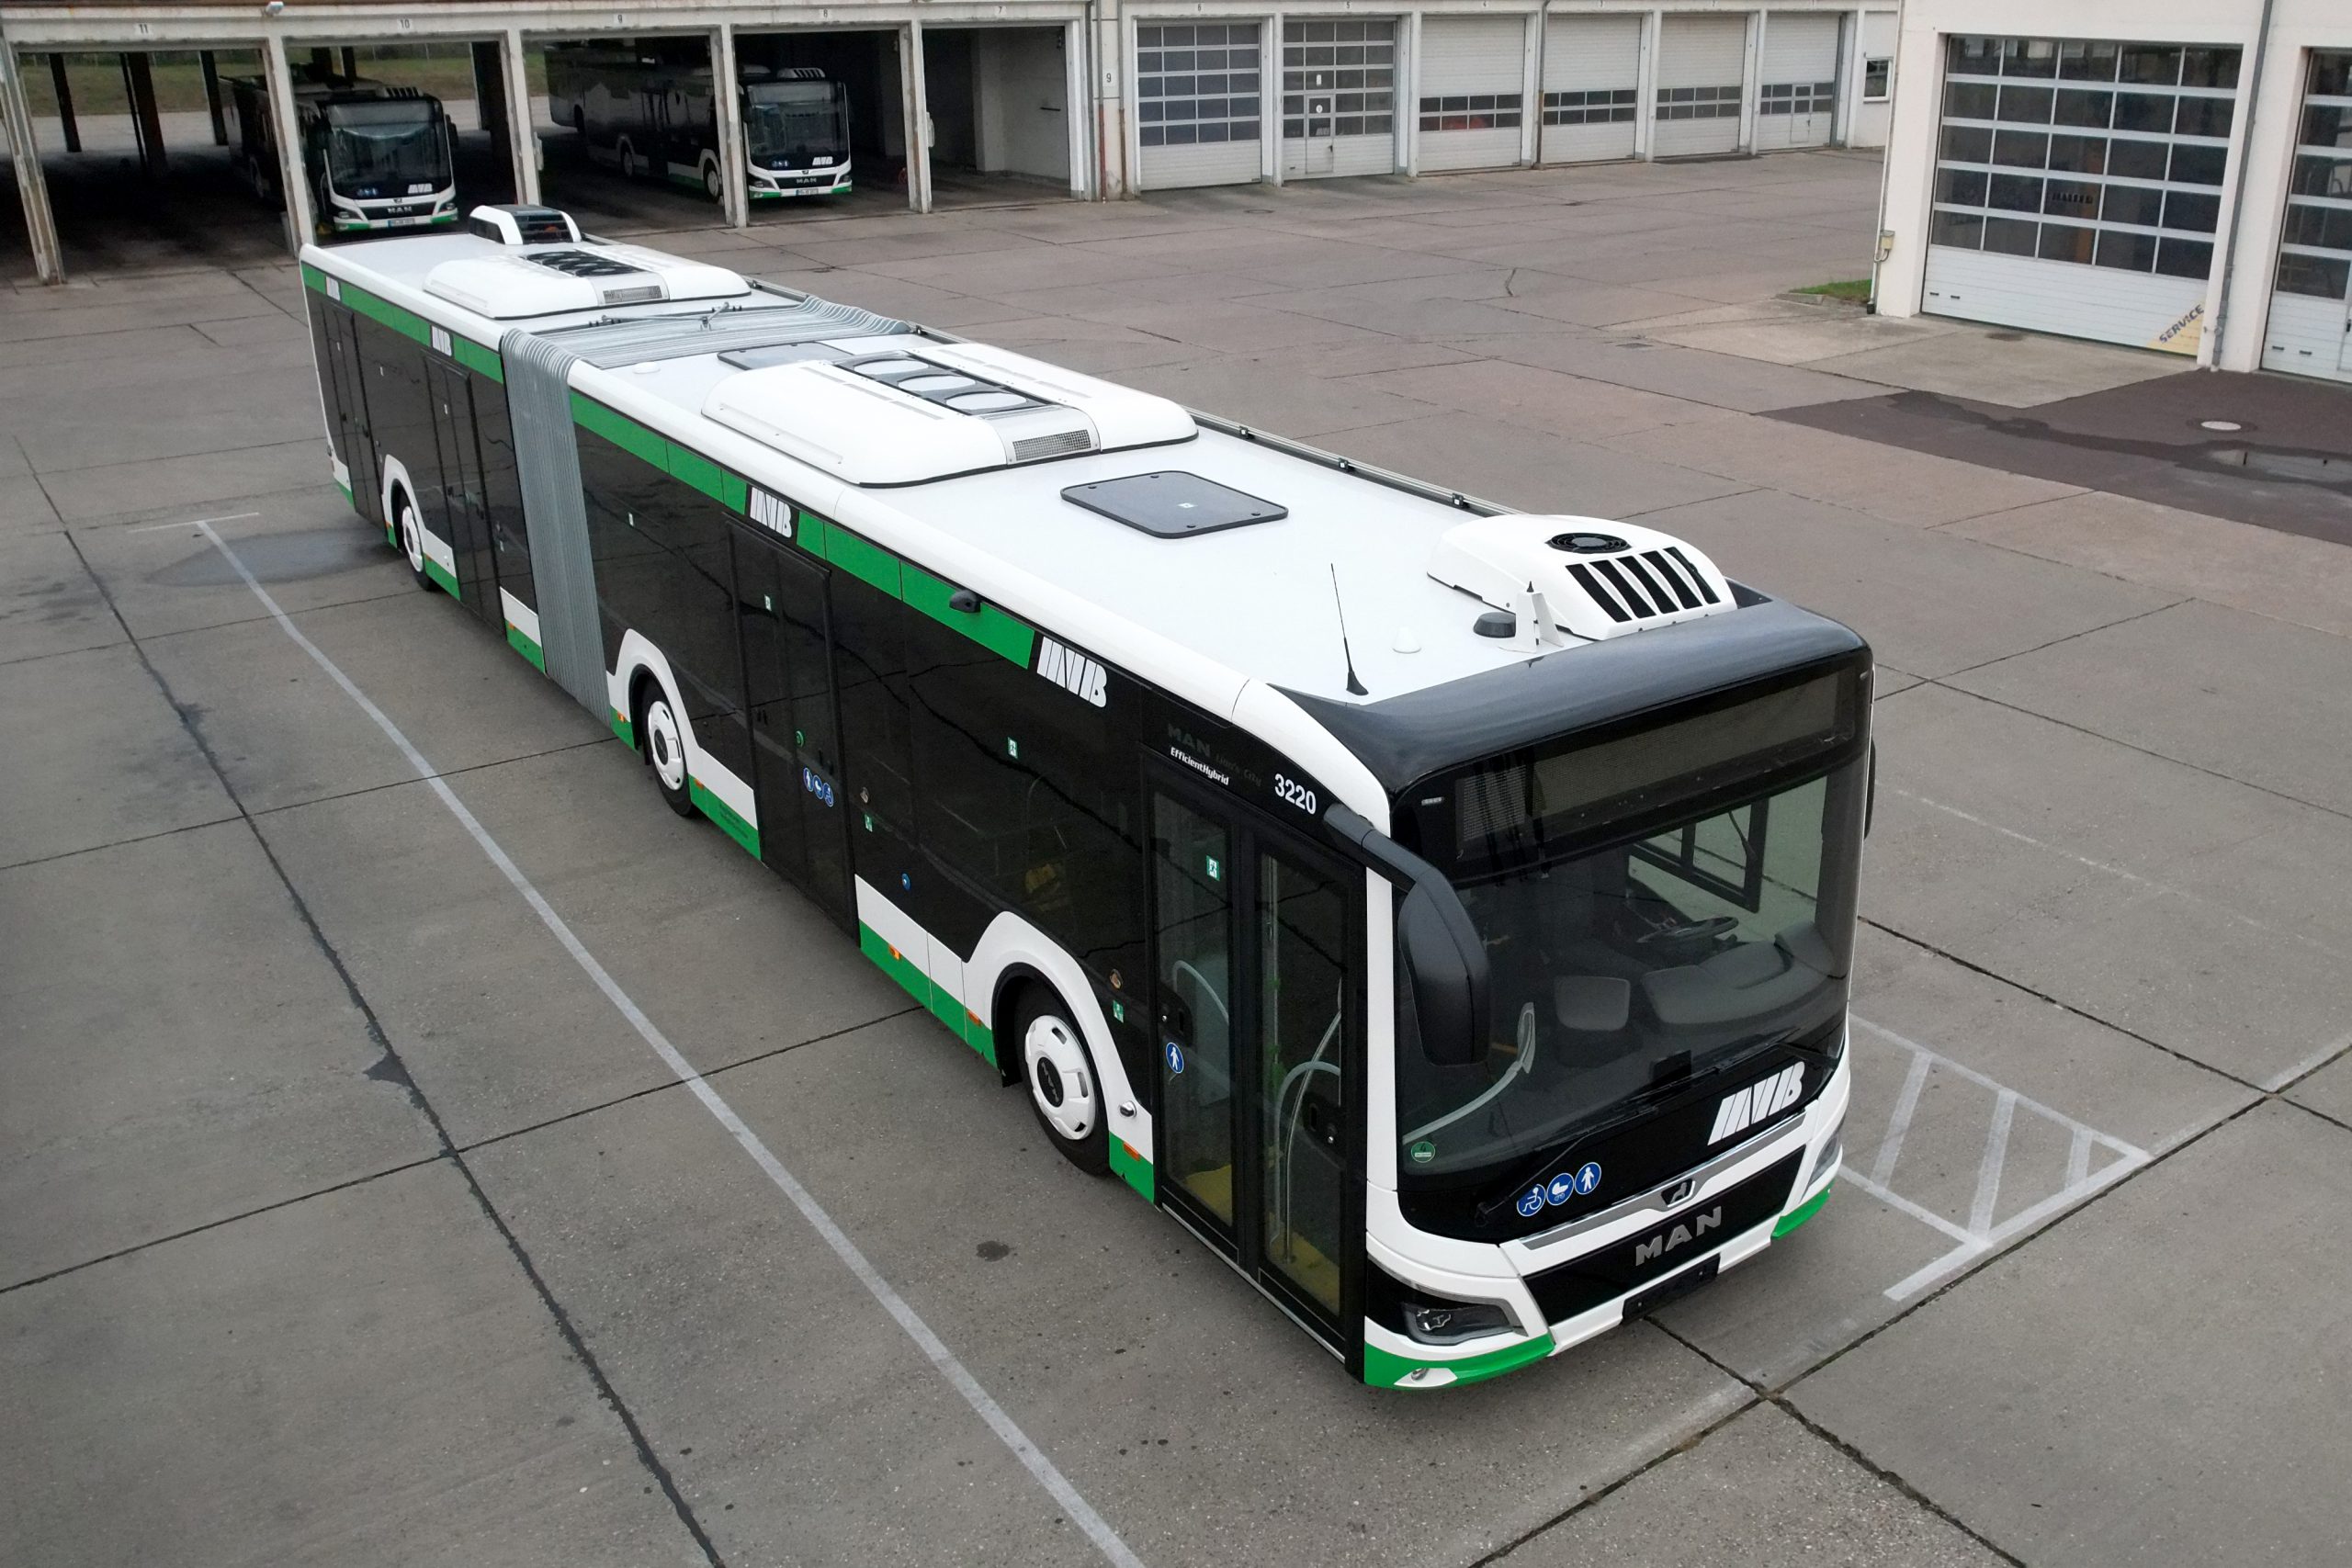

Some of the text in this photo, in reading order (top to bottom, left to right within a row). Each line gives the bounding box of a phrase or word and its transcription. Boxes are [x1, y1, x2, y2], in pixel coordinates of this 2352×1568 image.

[617, 14, 623, 24] 9
[1346, 0, 1351, 9] 5
[139, 24, 149, 34] 11
[400, 18, 411, 28] 10
[1106, 73, 1112, 83] 9
[797, 176, 817, 185] MAN
[387, 205, 413, 214] MAN
[2159, 303, 2205, 344] SERVICE
[750, 486, 793, 538] MVB
[1036, 636, 1107, 708] MVB
[1168, 723, 1211, 758] MAN
[1170, 746, 1230, 786] EfficientHybrid
[1274, 773, 1317, 816] 3220
[1707, 1061, 1805, 1146] MVB
[1634, 1205, 1723, 1267] MAN
